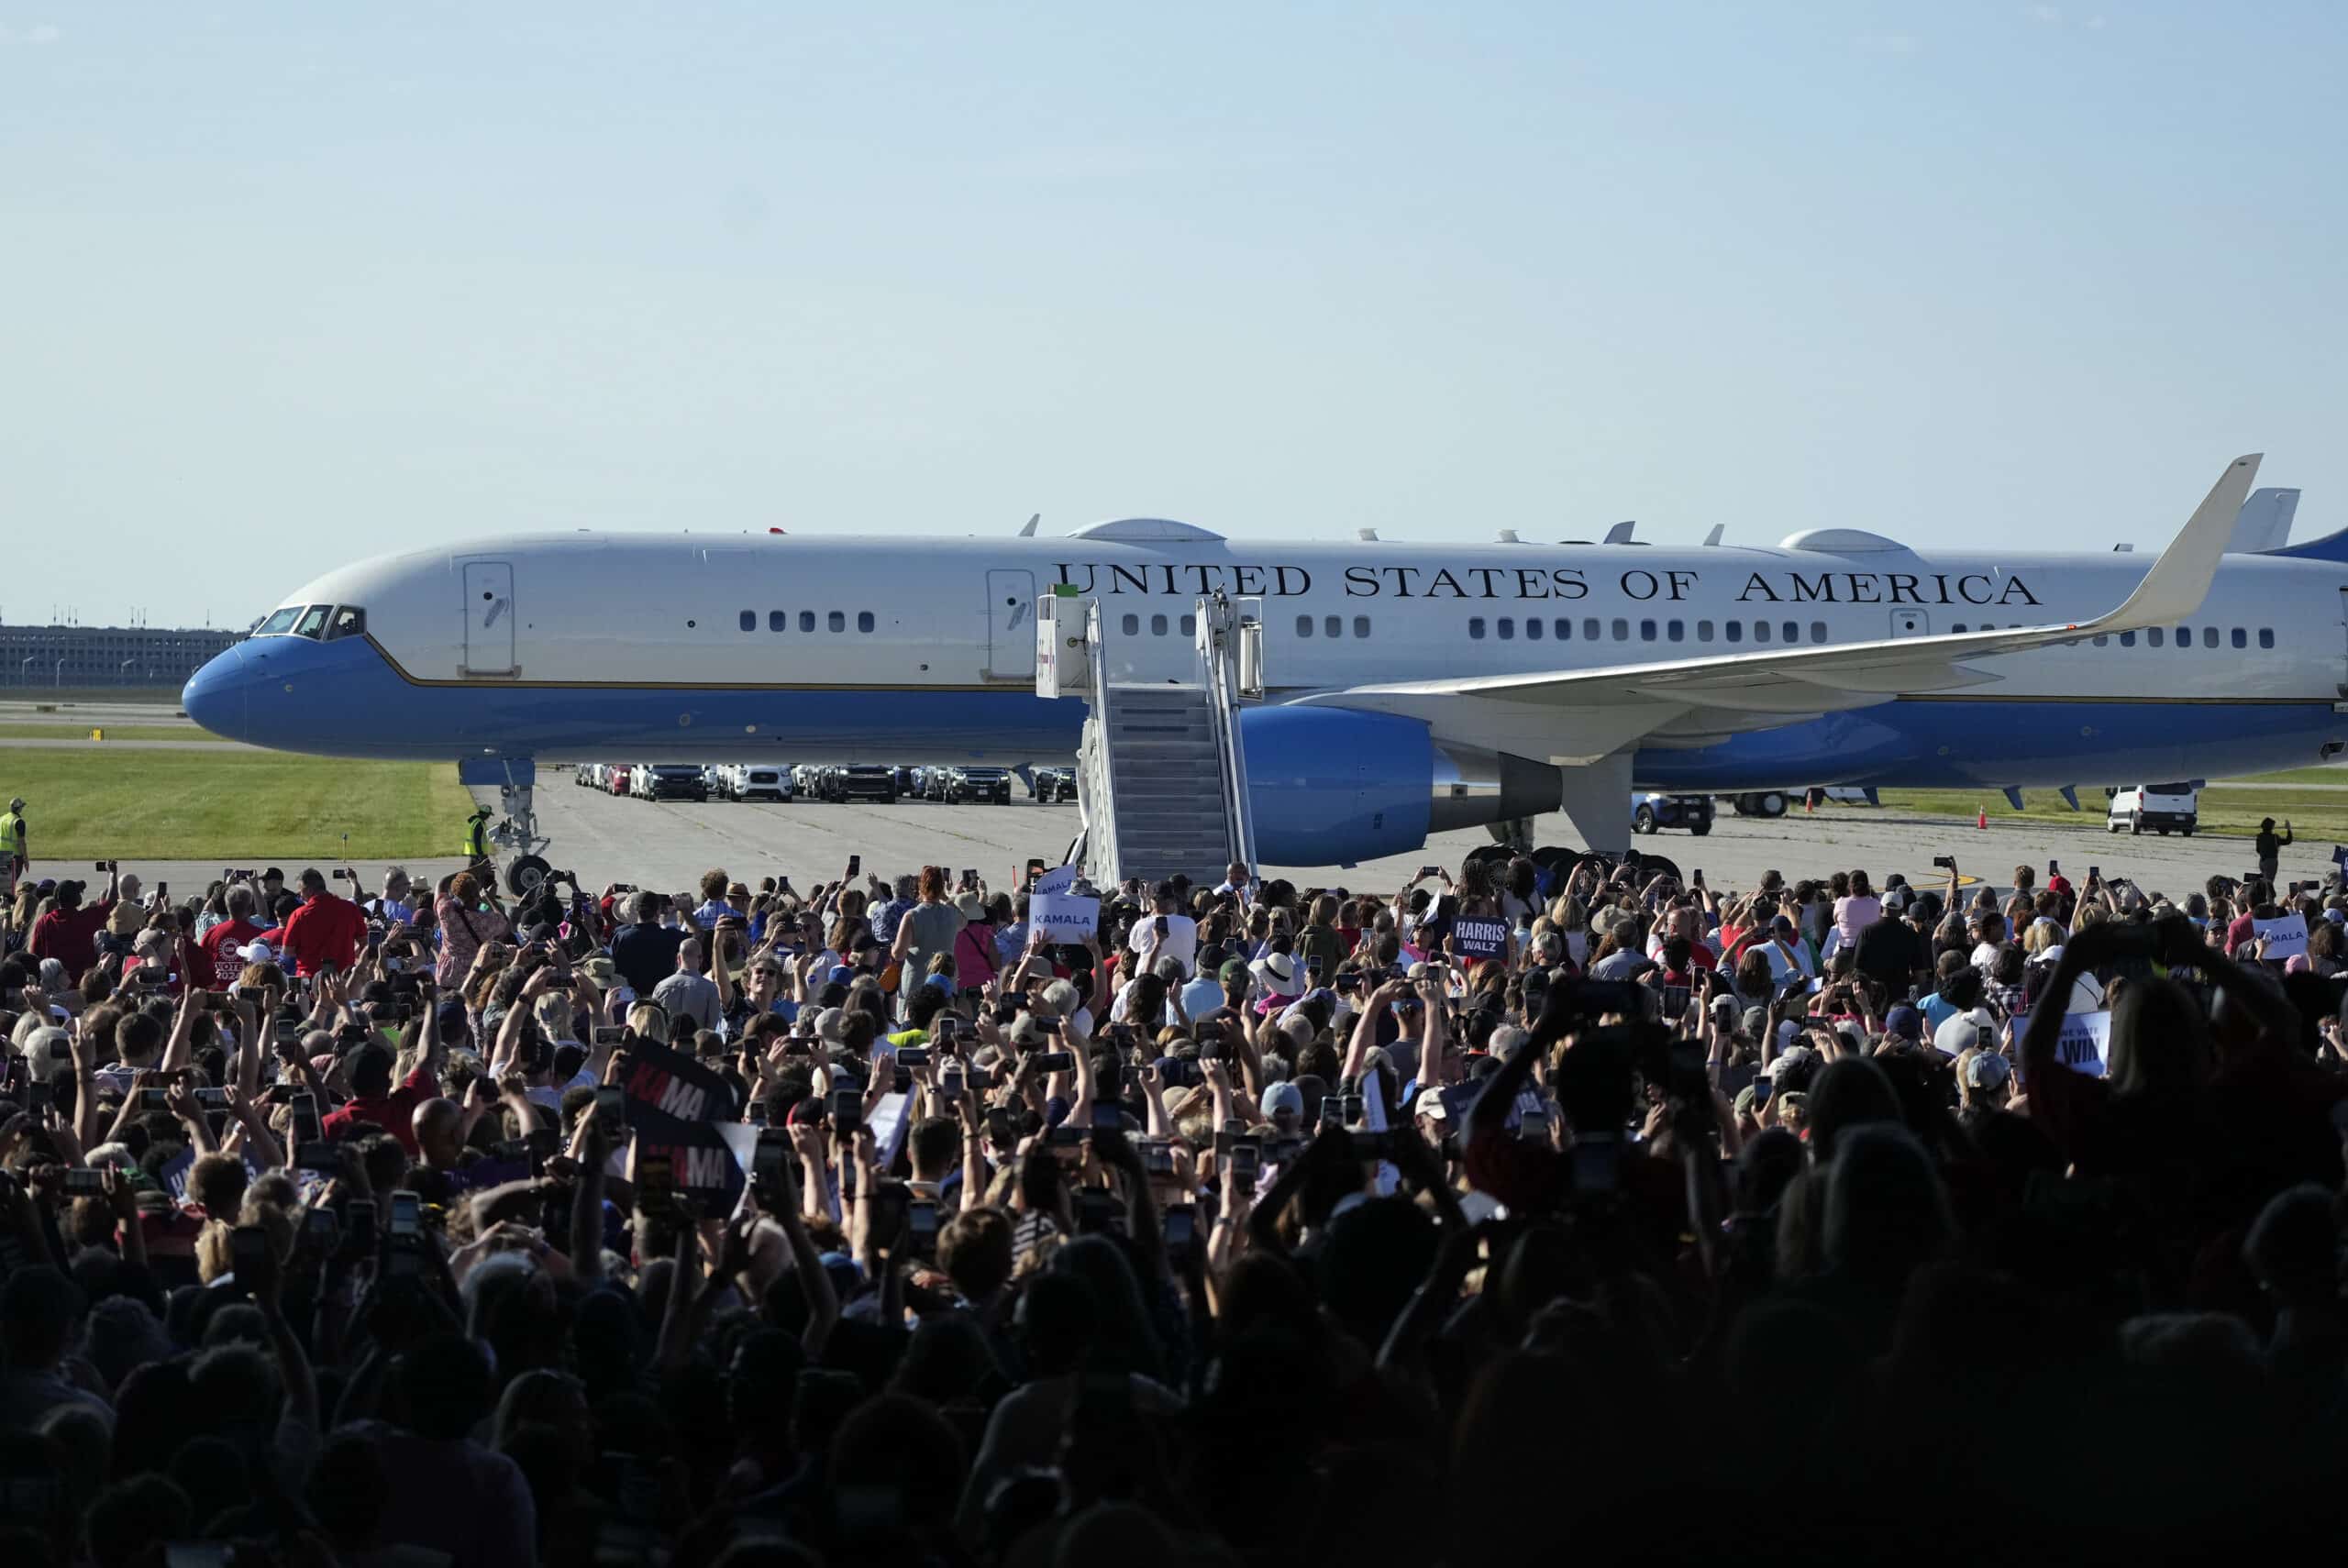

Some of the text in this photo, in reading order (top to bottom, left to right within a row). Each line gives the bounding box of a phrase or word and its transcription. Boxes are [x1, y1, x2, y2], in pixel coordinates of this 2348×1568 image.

[1052, 563, 2044, 605] UNITED STATES OF AMERICA
[1035, 915, 1090, 925] KAMALA
[1456, 922, 1506, 942] HARRIS
[1463, 940, 1497, 953] WALZ
[215, 961, 242, 972] VOTE
[2062, 1036, 2100, 1065] WIN
